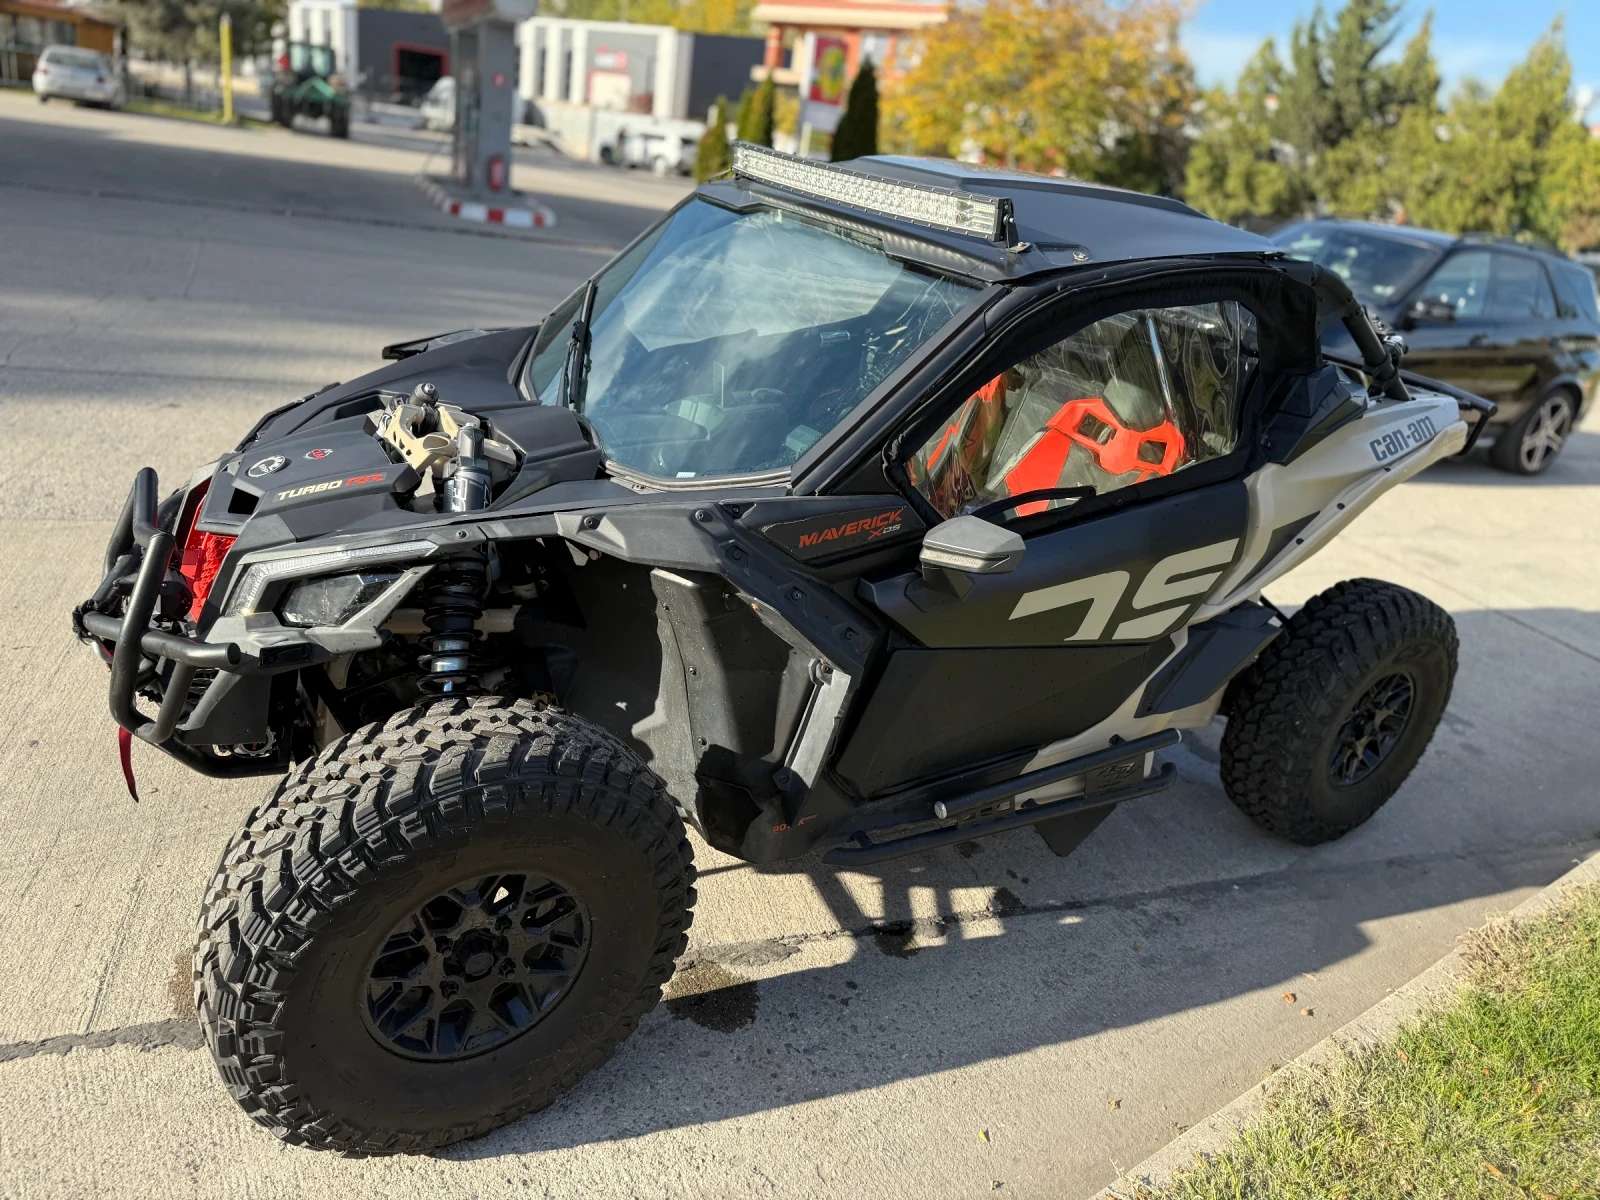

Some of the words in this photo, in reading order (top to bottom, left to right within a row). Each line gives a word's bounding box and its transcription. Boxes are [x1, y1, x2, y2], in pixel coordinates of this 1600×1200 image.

[1369, 415, 1437, 462] can-am
[278, 479, 343, 501] TURBO
[345, 473, 384, 487] RR
[798, 509, 904, 548] MAVERICK
